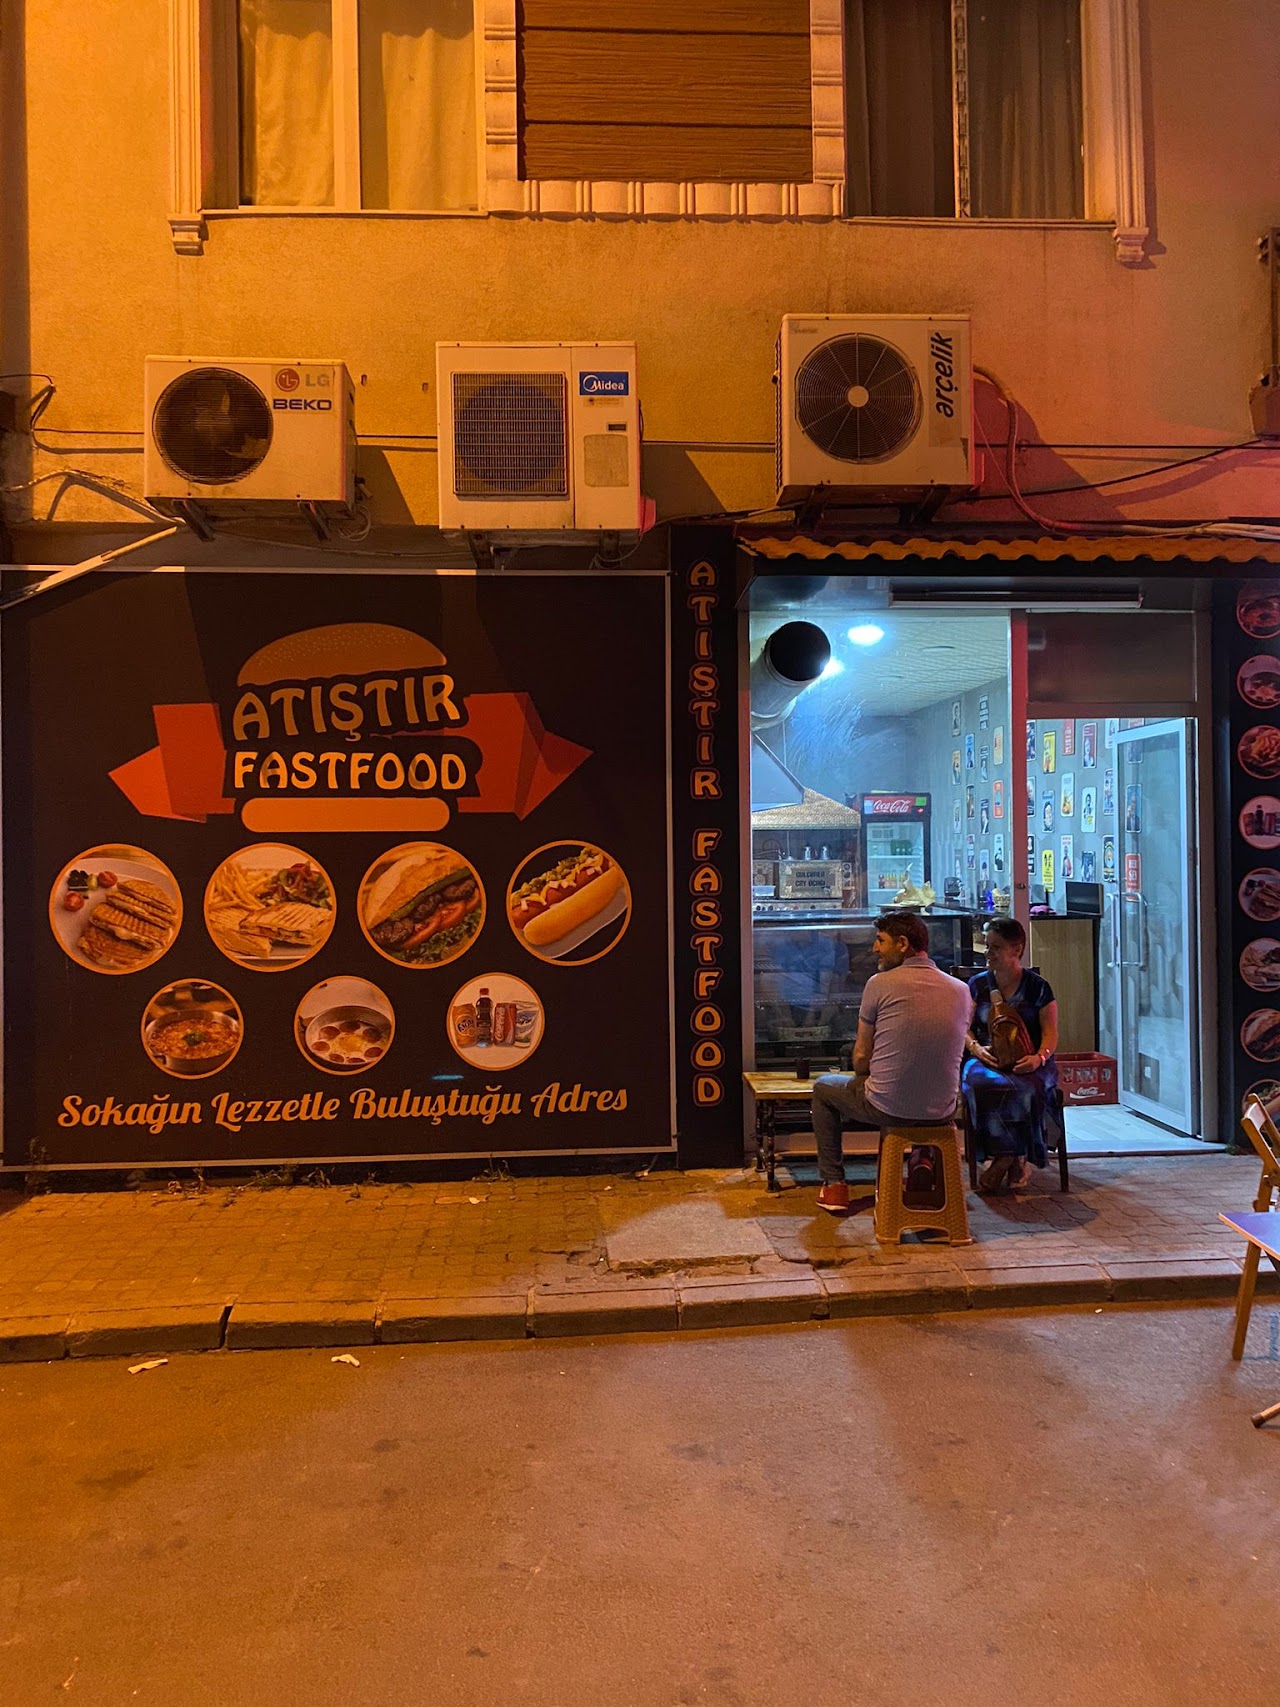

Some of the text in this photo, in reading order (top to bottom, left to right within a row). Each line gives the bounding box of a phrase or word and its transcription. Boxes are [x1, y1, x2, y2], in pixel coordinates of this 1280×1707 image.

[304, 373, 330, 387] LG
[586, 377, 625, 391] Midea
[929, 332, 958, 418] arçelik
[273, 398, 332, 411] BEKO
[232, 674, 460, 742] ATIŞTIR
[233, 751, 467, 790] FASTFOOD
[690, 560, 721, 1102] ATIŞTIR FASTFOOD
[57, 1082, 628, 1134] Sokağın Lezzetle Buluştuğu Adres
